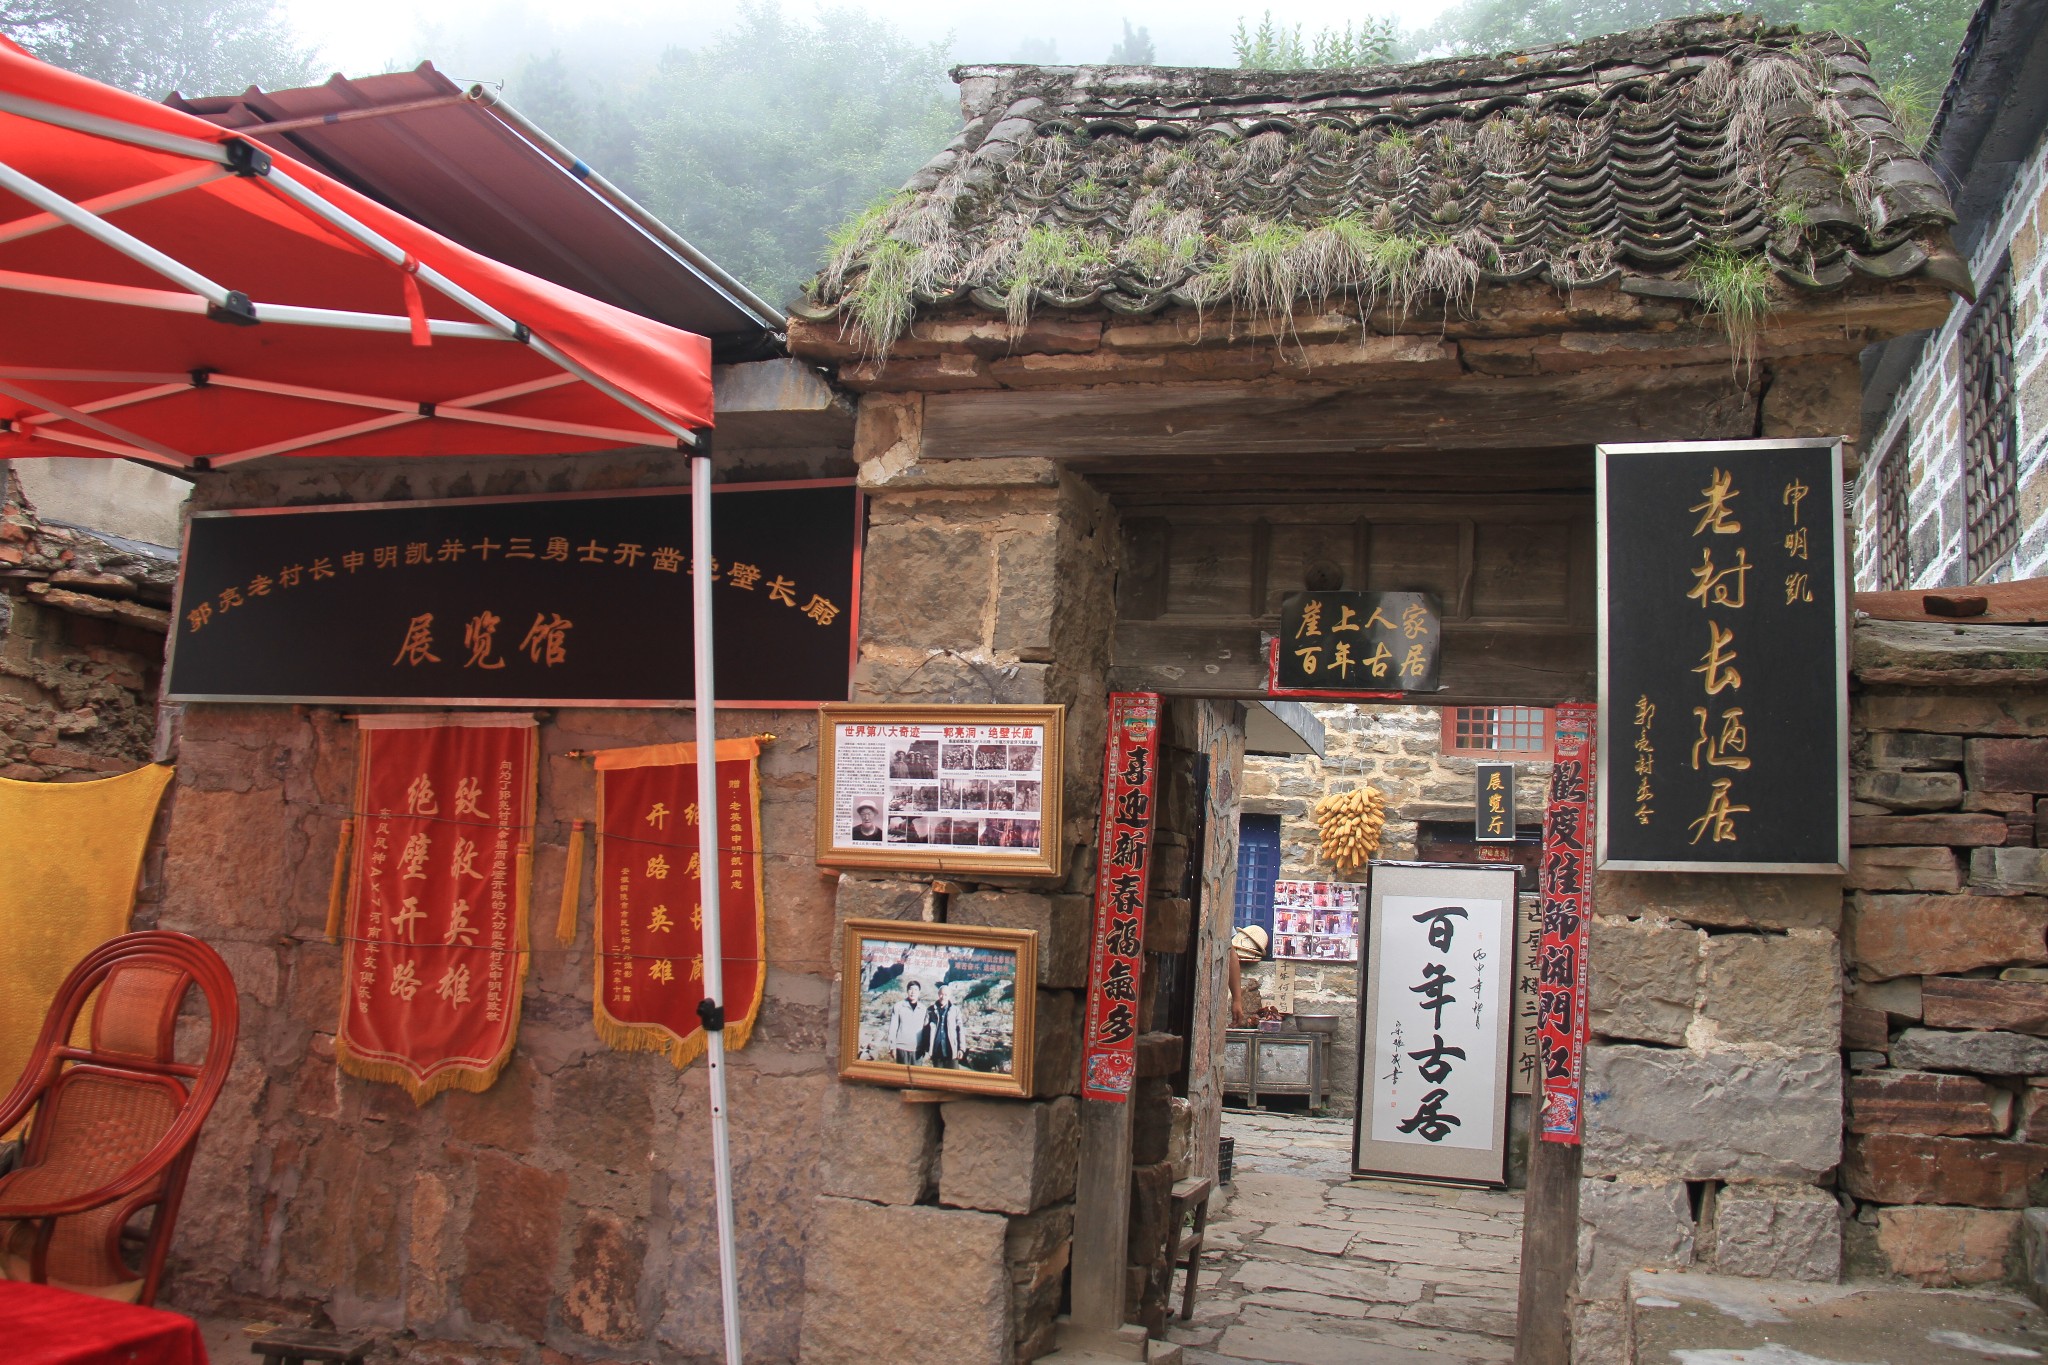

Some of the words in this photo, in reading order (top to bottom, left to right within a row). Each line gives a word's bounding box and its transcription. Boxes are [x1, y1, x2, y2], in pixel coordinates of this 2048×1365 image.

[393, 609, 575, 670] 展览馆
[1293, 642, 1427, 680] 百年古居
[1295, 601, 1428, 639] 崖上人家
[1686, 466, 1753, 846] 老村长陋居
[390, 773, 439, 1002] 绝壁开路
[435, 776, 490, 1010] 致敬英雄
[645, 802, 675, 986] 开路英雄
[1097, 746, 1152, 1045] 喜迎新春福氣多
[1485, 771, 1505, 836] 展览厅
[1396, 905, 1469, 1142] 百年古居
